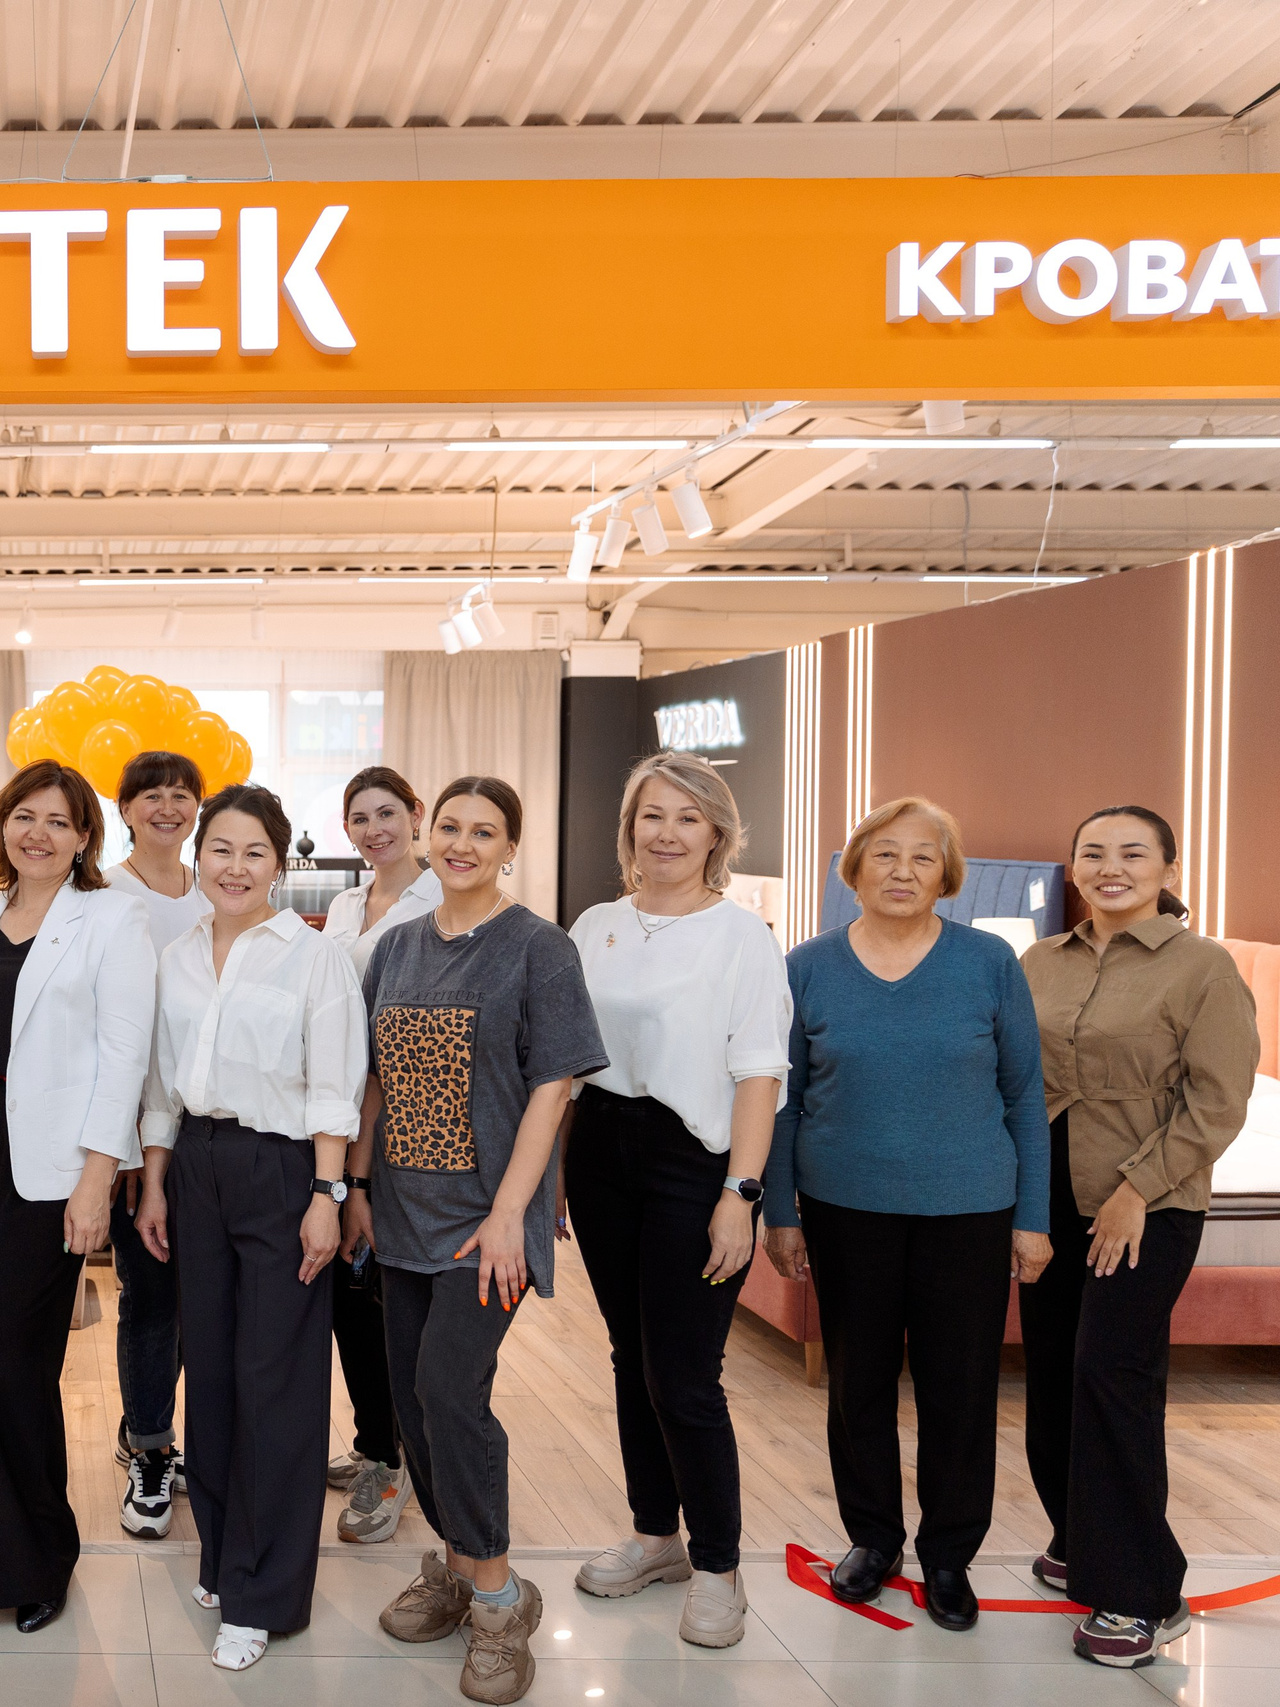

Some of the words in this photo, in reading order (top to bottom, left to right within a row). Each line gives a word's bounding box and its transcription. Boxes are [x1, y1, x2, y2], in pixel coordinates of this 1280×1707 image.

[654, 699, 742, 749] VERDA
[381, 989, 409, 1001] NEW
[411, 989, 486, 1003] ATTITUDE
